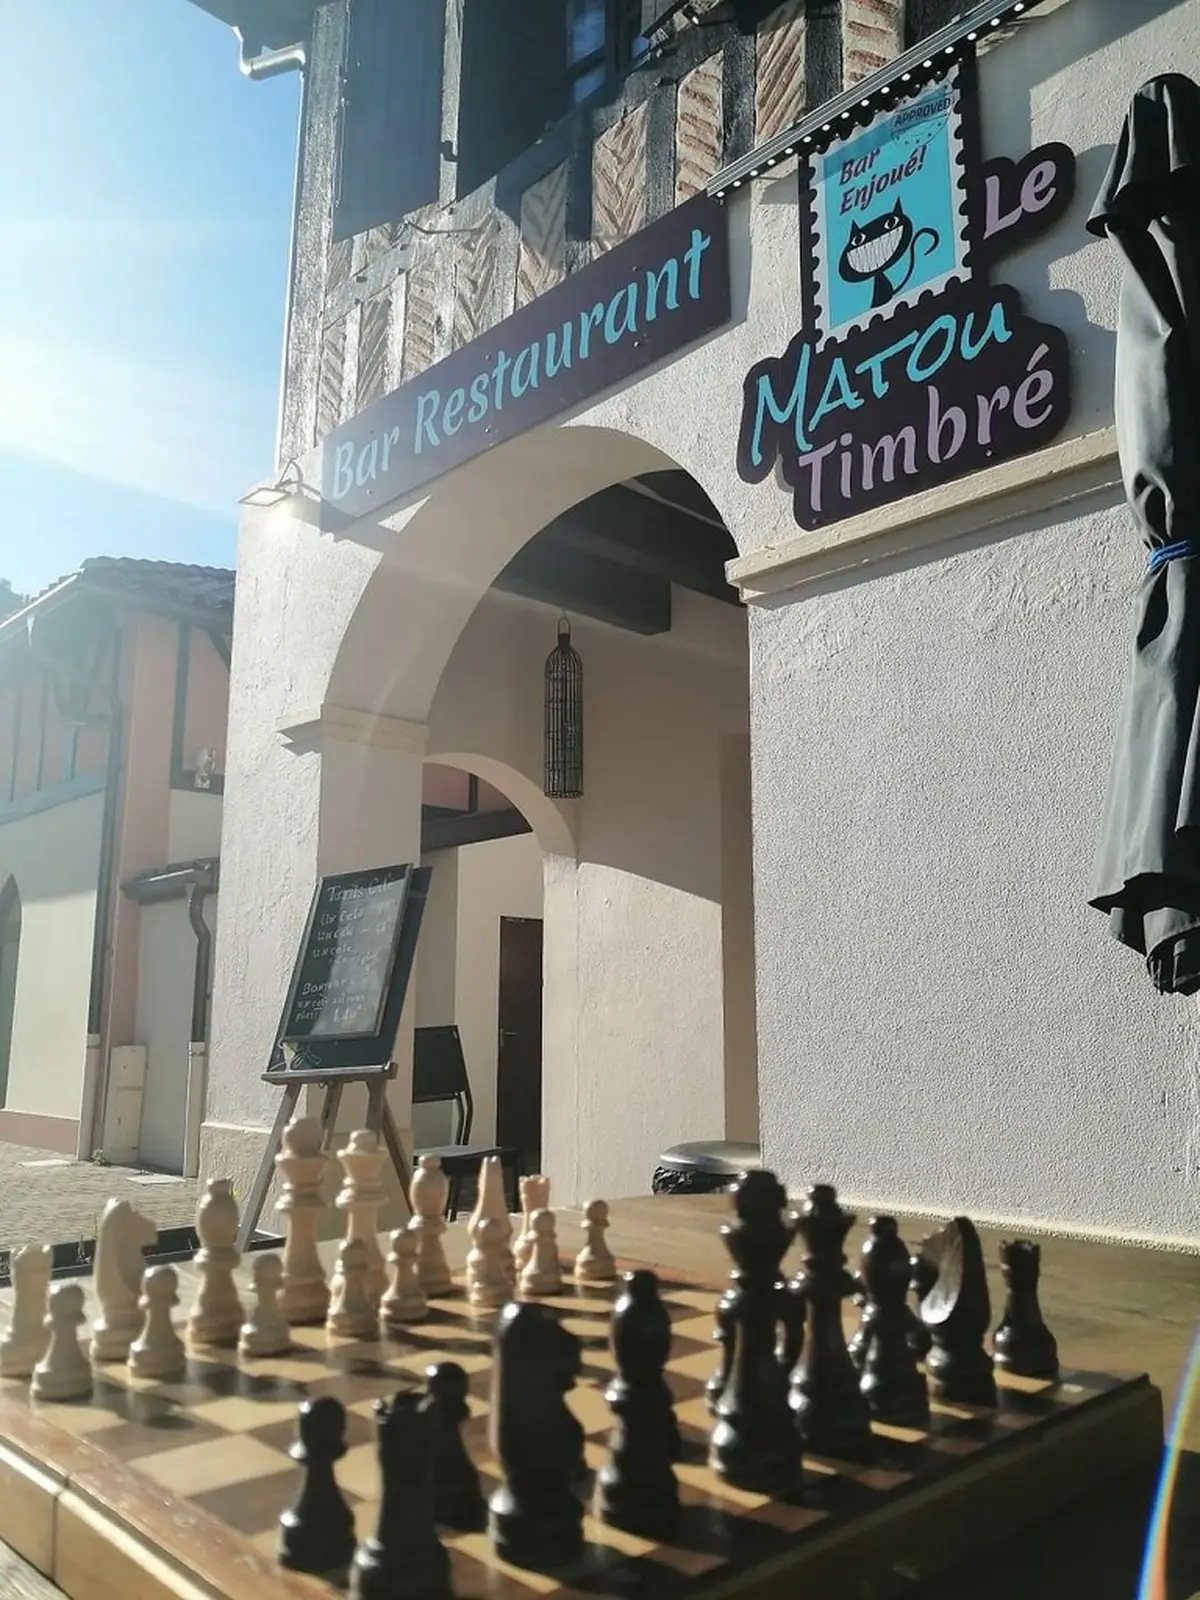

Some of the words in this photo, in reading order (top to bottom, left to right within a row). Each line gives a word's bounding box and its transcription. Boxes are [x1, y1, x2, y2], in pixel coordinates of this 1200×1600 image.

[893, 97, 952, 128] APPROVED
[839, 146, 880, 187] Bar
[839, 144, 928, 216] Enjoué!
[984, 159, 1058, 240] Le
[331, 425, 400, 500] Bar
[413, 228, 712, 455] Restaurant
[798, 343, 1056, 513] Timbré
